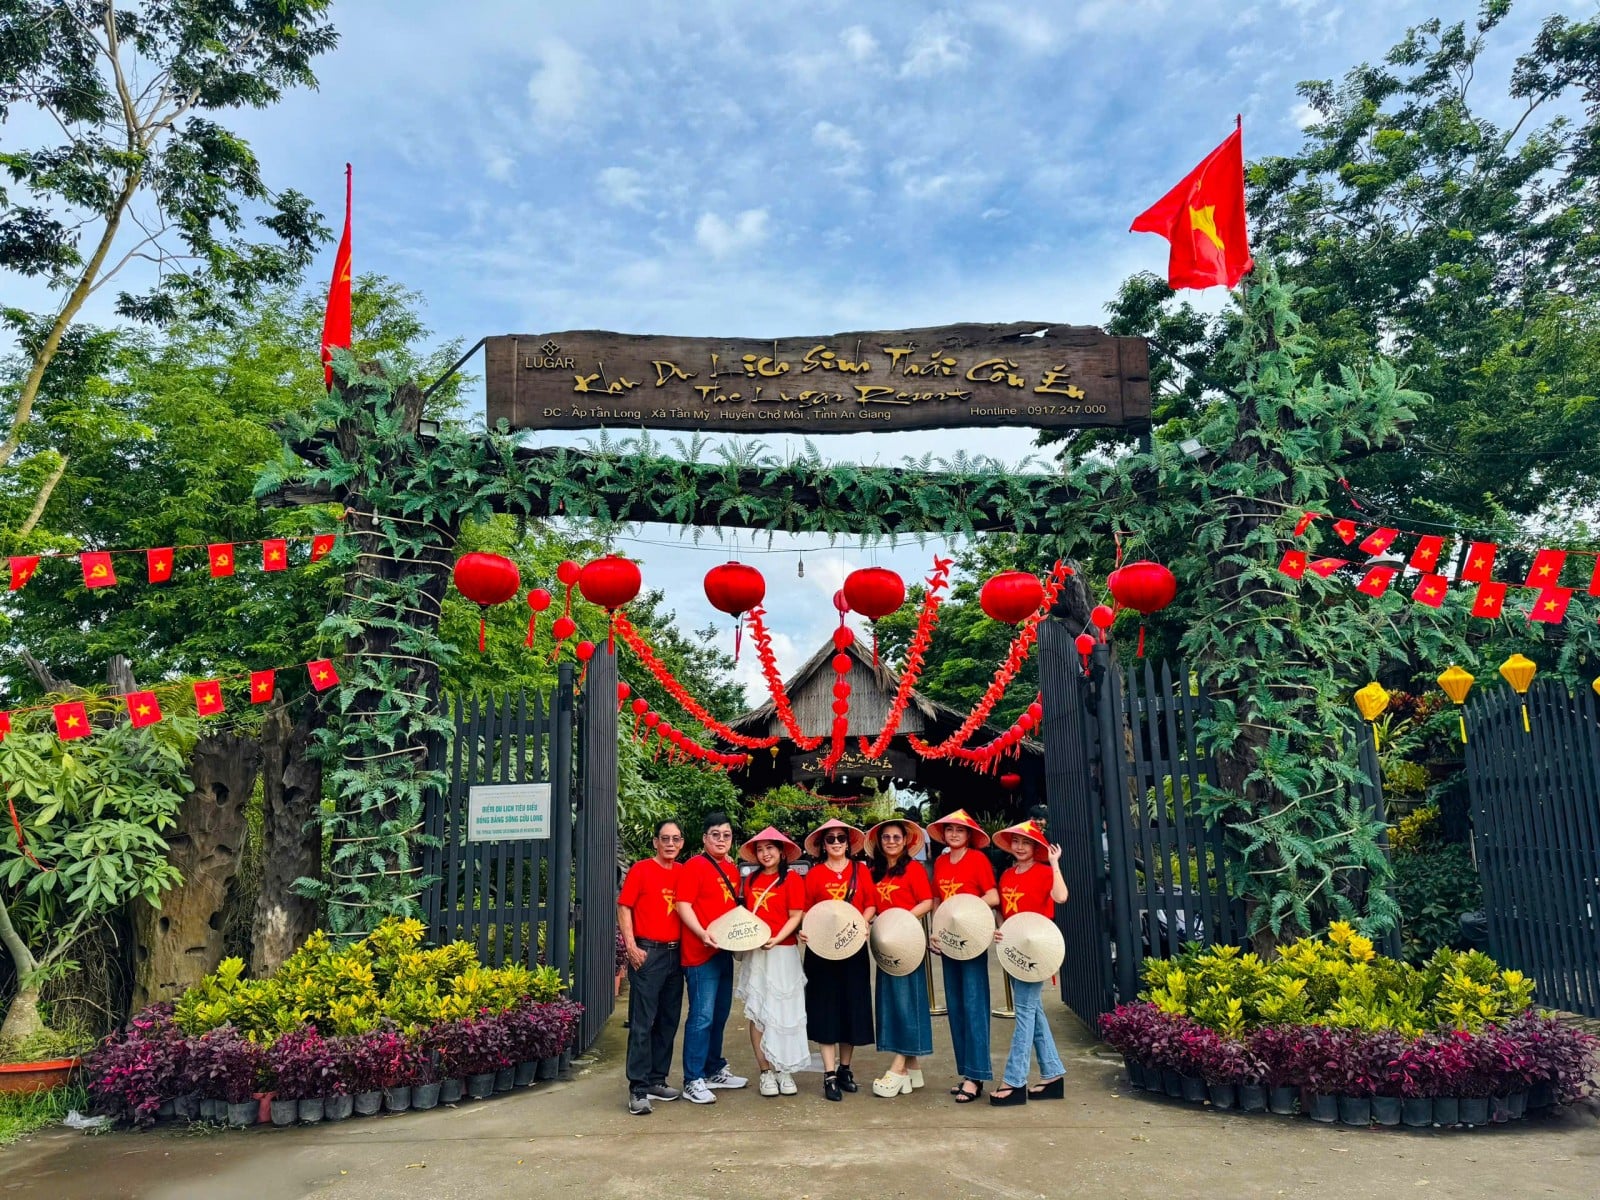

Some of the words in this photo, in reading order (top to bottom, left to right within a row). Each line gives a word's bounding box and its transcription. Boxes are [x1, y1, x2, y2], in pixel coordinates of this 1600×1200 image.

[525, 356, 575, 369] LUGAR
[710, 340, 790, 377] Lịch
[802, 339, 870, 373] Sinh
[883, 342, 957, 376] Thái
[966, 358, 1025, 388] Cồn
[1033, 364, 1085, 400] Én
[694, 381, 744, 403] The
[751, 386, 847, 408] Lugar
[854, 386, 972, 407] Resort
[614, 408, 641, 419] Long
[840, 410, 855, 419] An
[858, 410, 891, 420] Giang
[970, 406, 1017, 416] Hontline
[1027, 405, 1106, 415] 0917.247.000
